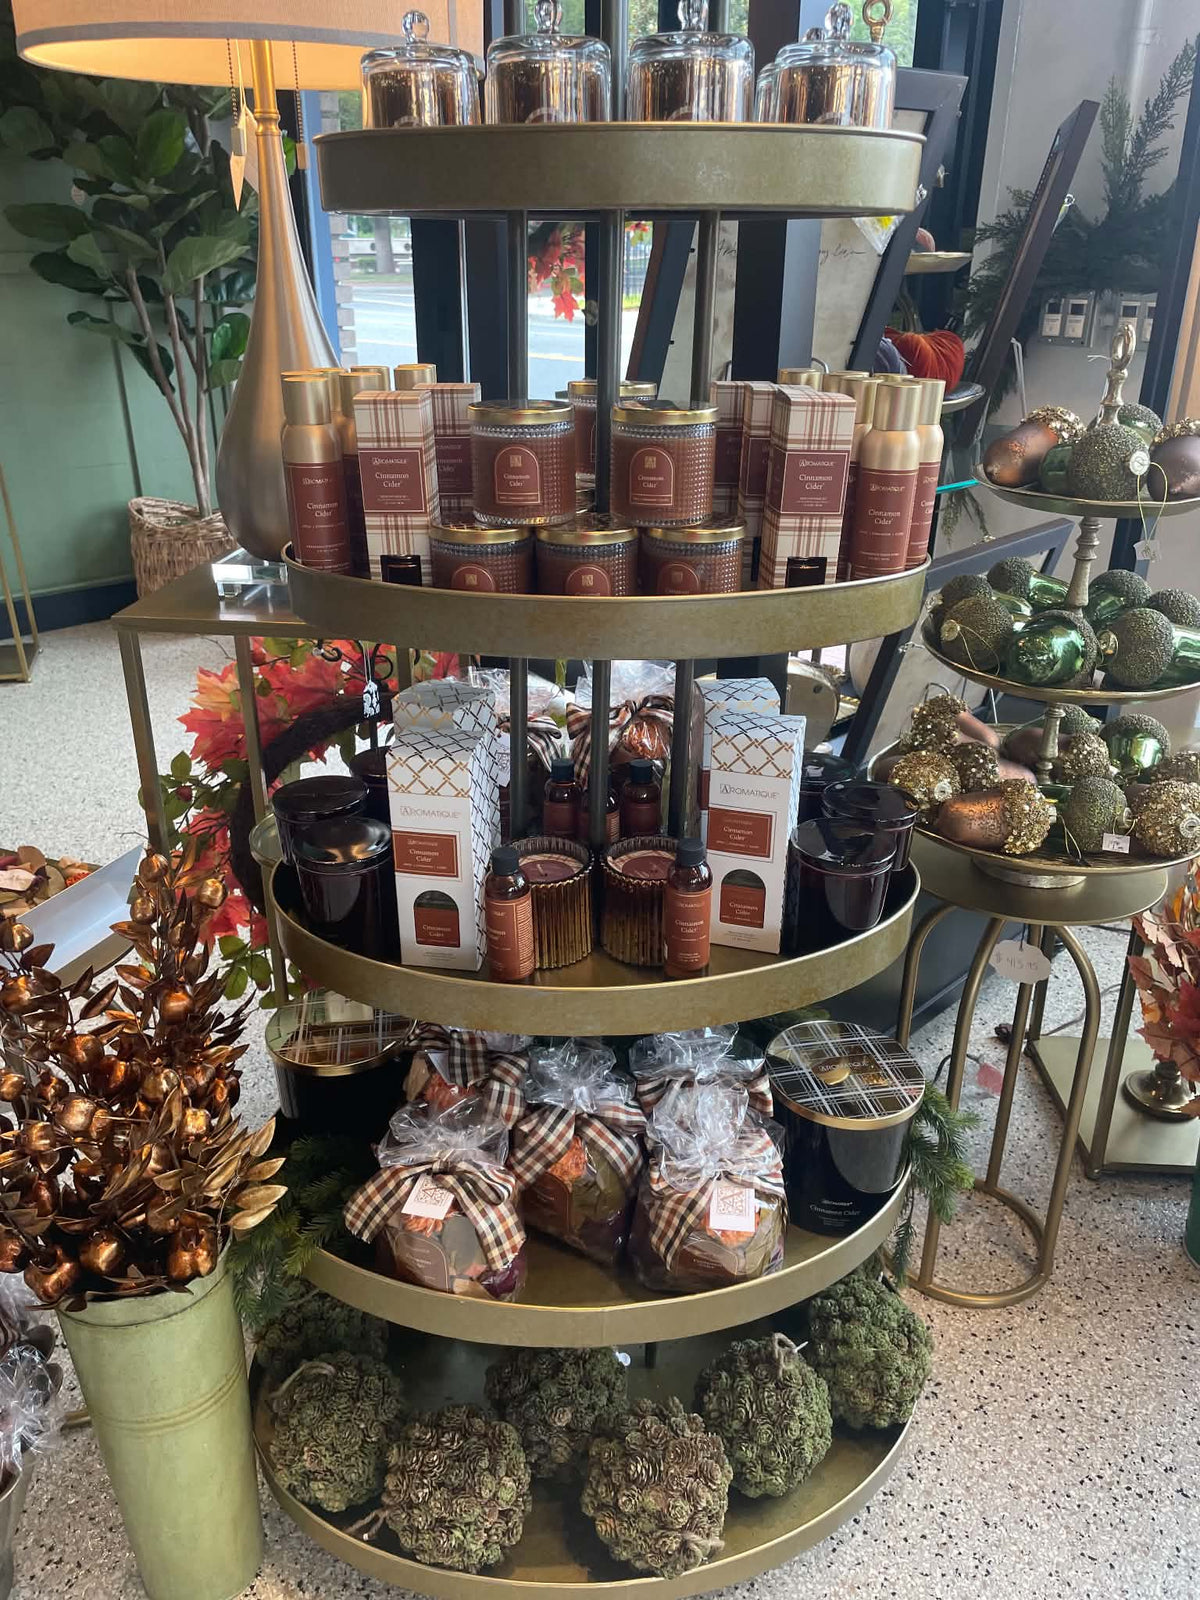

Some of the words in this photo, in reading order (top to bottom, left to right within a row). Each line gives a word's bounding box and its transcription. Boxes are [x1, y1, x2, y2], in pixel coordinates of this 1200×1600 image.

[375, 471, 410, 479] Cinnamon
[382, 480, 402, 488] Cider
[805, 481, 824, 490] Cider
[306, 502, 339, 511] Cinnamon
[874, 516, 894, 525] Cider
[720, 783, 778, 799] AROMATIQUE
[400, 804, 461, 818] AROMATIQUE
[723, 826, 753, 835] Cinnamon
[409, 848, 440, 856] Cinnamon
[415, 855, 432, 863] Cider
[809, 1204, 842, 1216] Cinnamon
